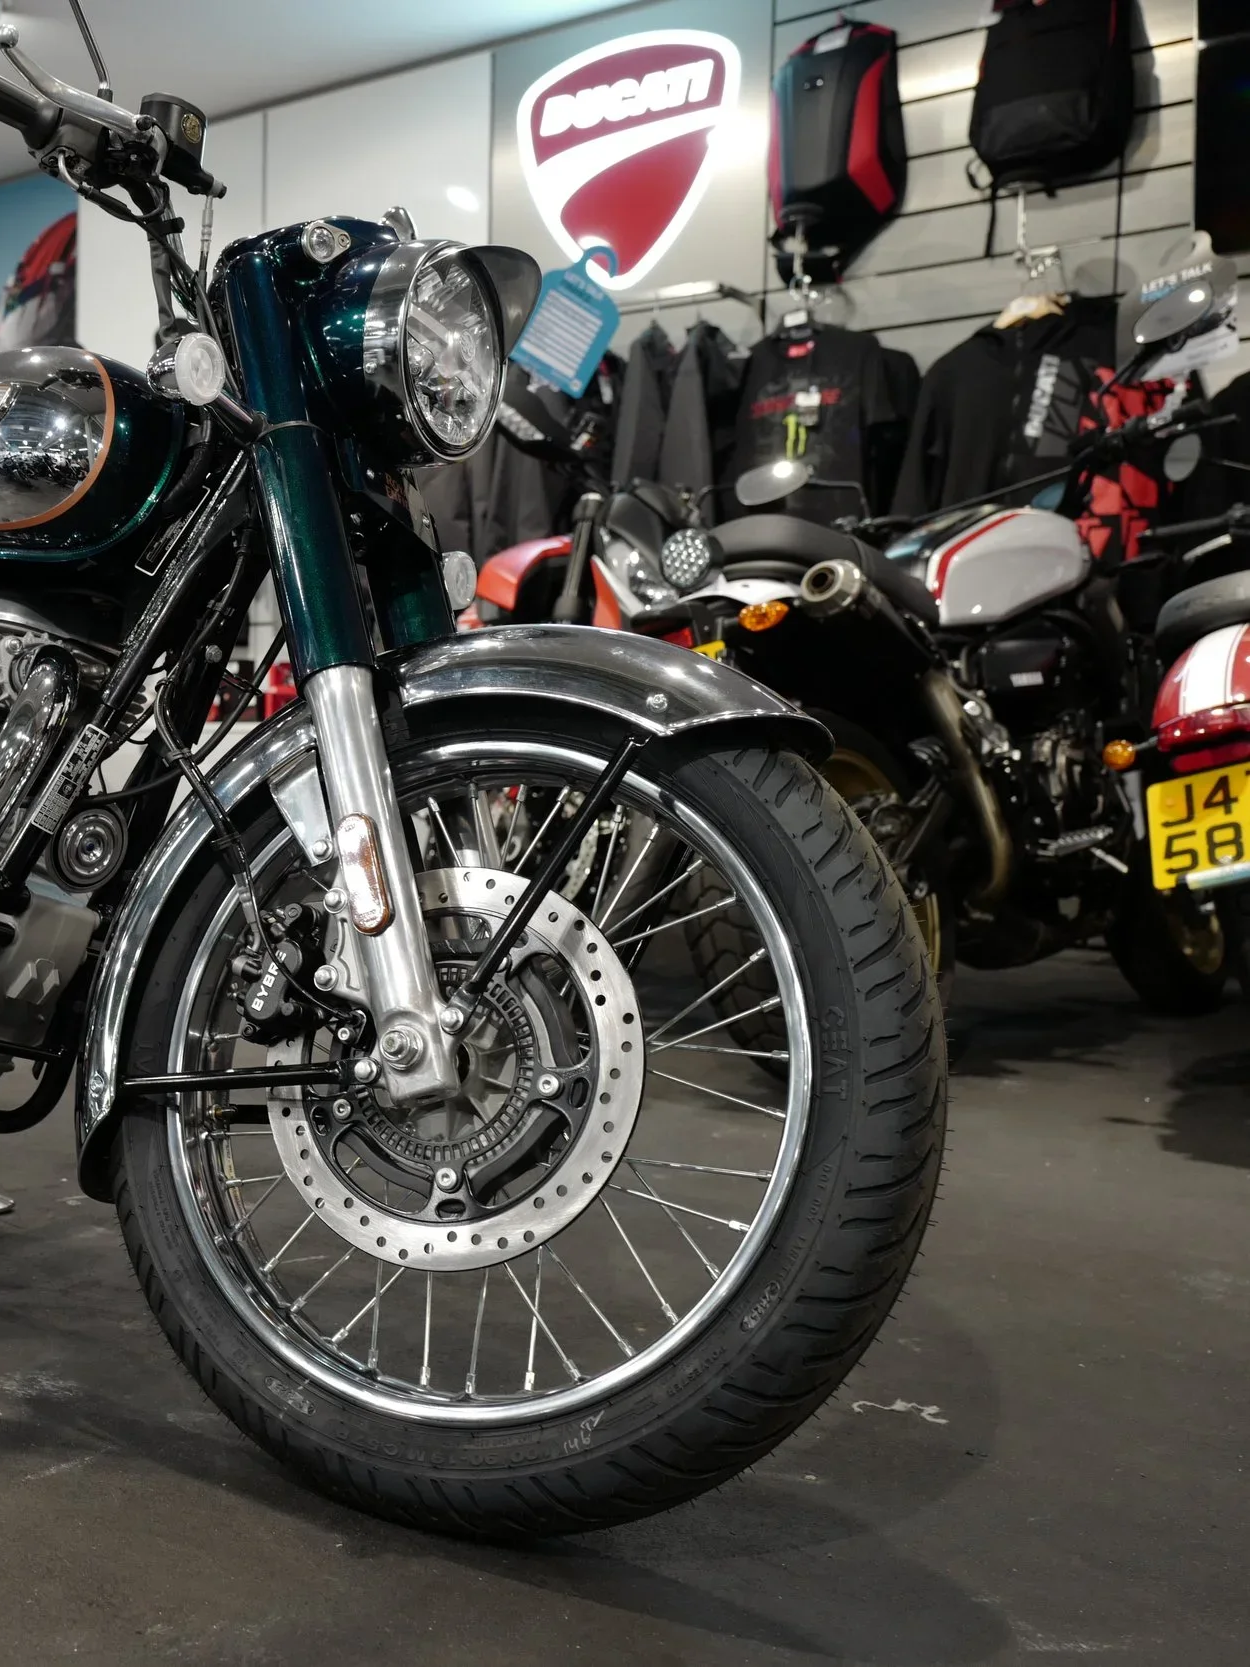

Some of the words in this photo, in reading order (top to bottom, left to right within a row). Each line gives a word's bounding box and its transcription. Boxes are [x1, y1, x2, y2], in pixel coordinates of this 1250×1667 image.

[539, 58, 715, 137] DUCATI
[1141, 273, 1177, 294] LET'S
[1181, 261, 1213, 281] TALK
[1024, 353, 1060, 438] DUCATI
[1161, 770, 1250, 828] J4
[1163, 821, 1245, 876] 58
[251, 949, 287, 1012] BYBRE
[820, 1005, 849, 1101] CEAT
